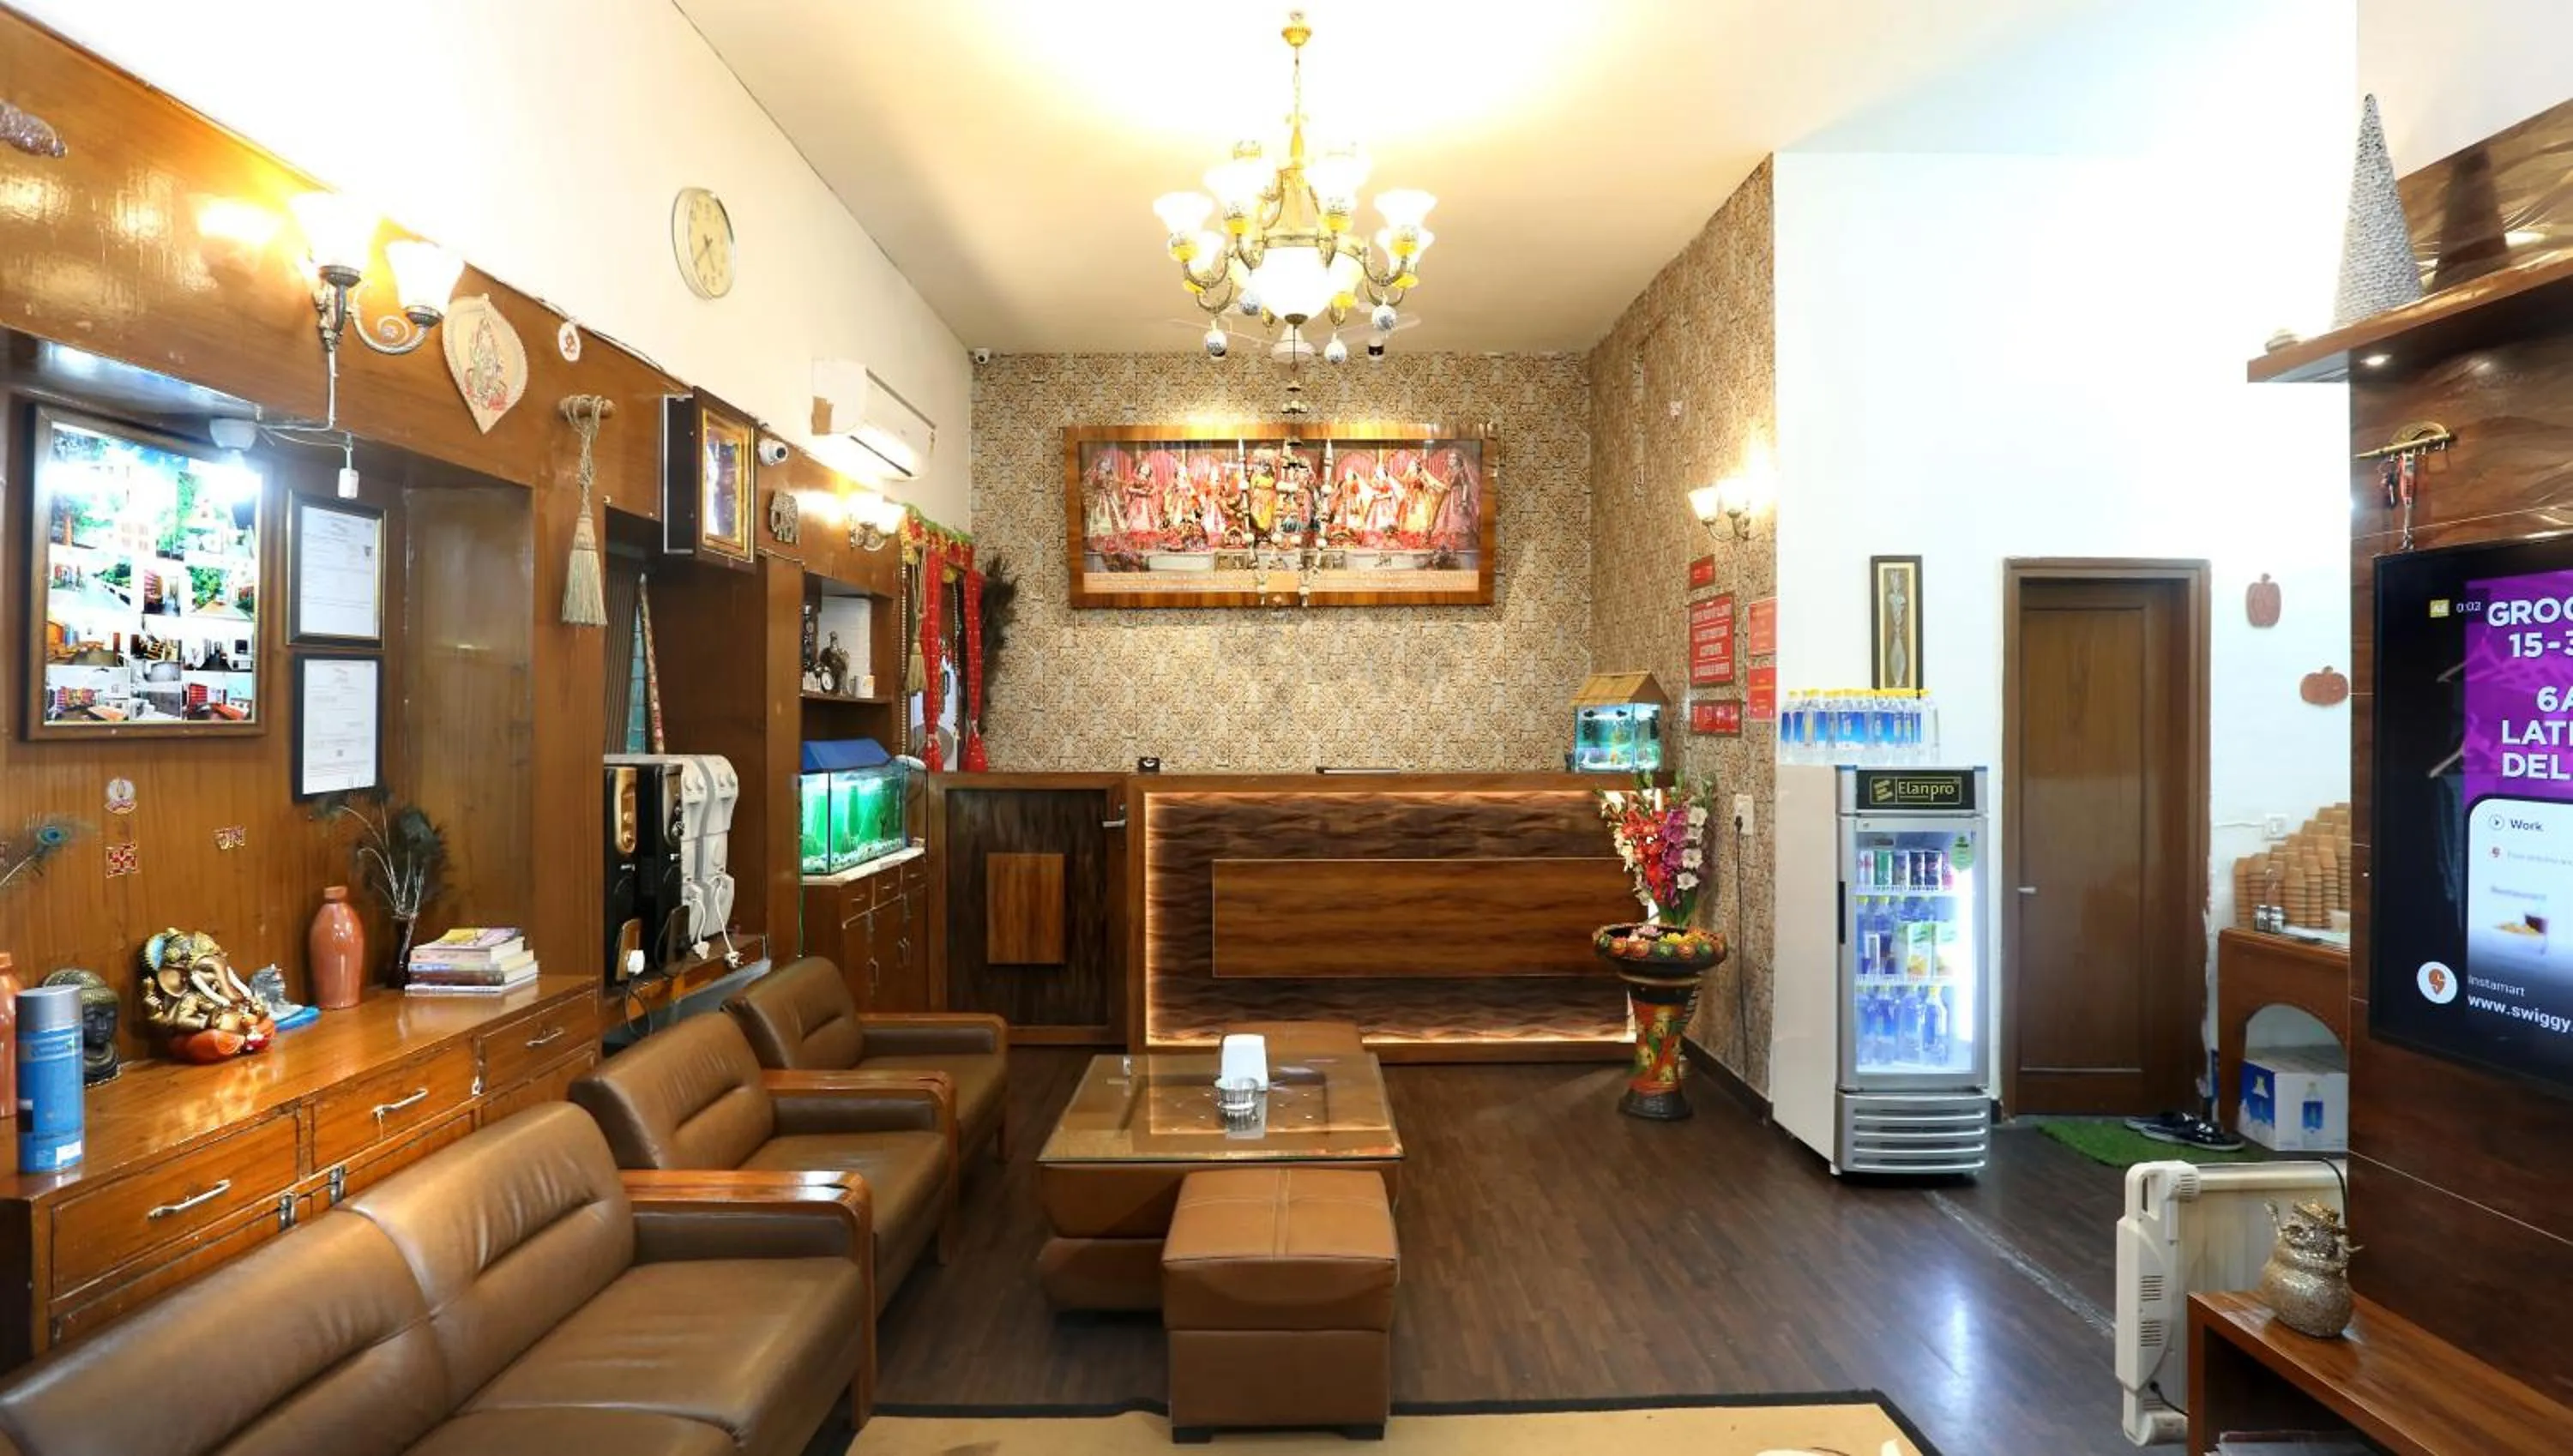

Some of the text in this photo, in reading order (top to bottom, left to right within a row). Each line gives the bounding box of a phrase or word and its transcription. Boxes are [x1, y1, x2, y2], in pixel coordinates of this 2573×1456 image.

[2501, 719, 2573, 746] LAT
[1897, 781, 1955, 802] Elanpro
[2510, 818, 2545, 832] Work
[2468, 974, 2526, 997] Instamart
